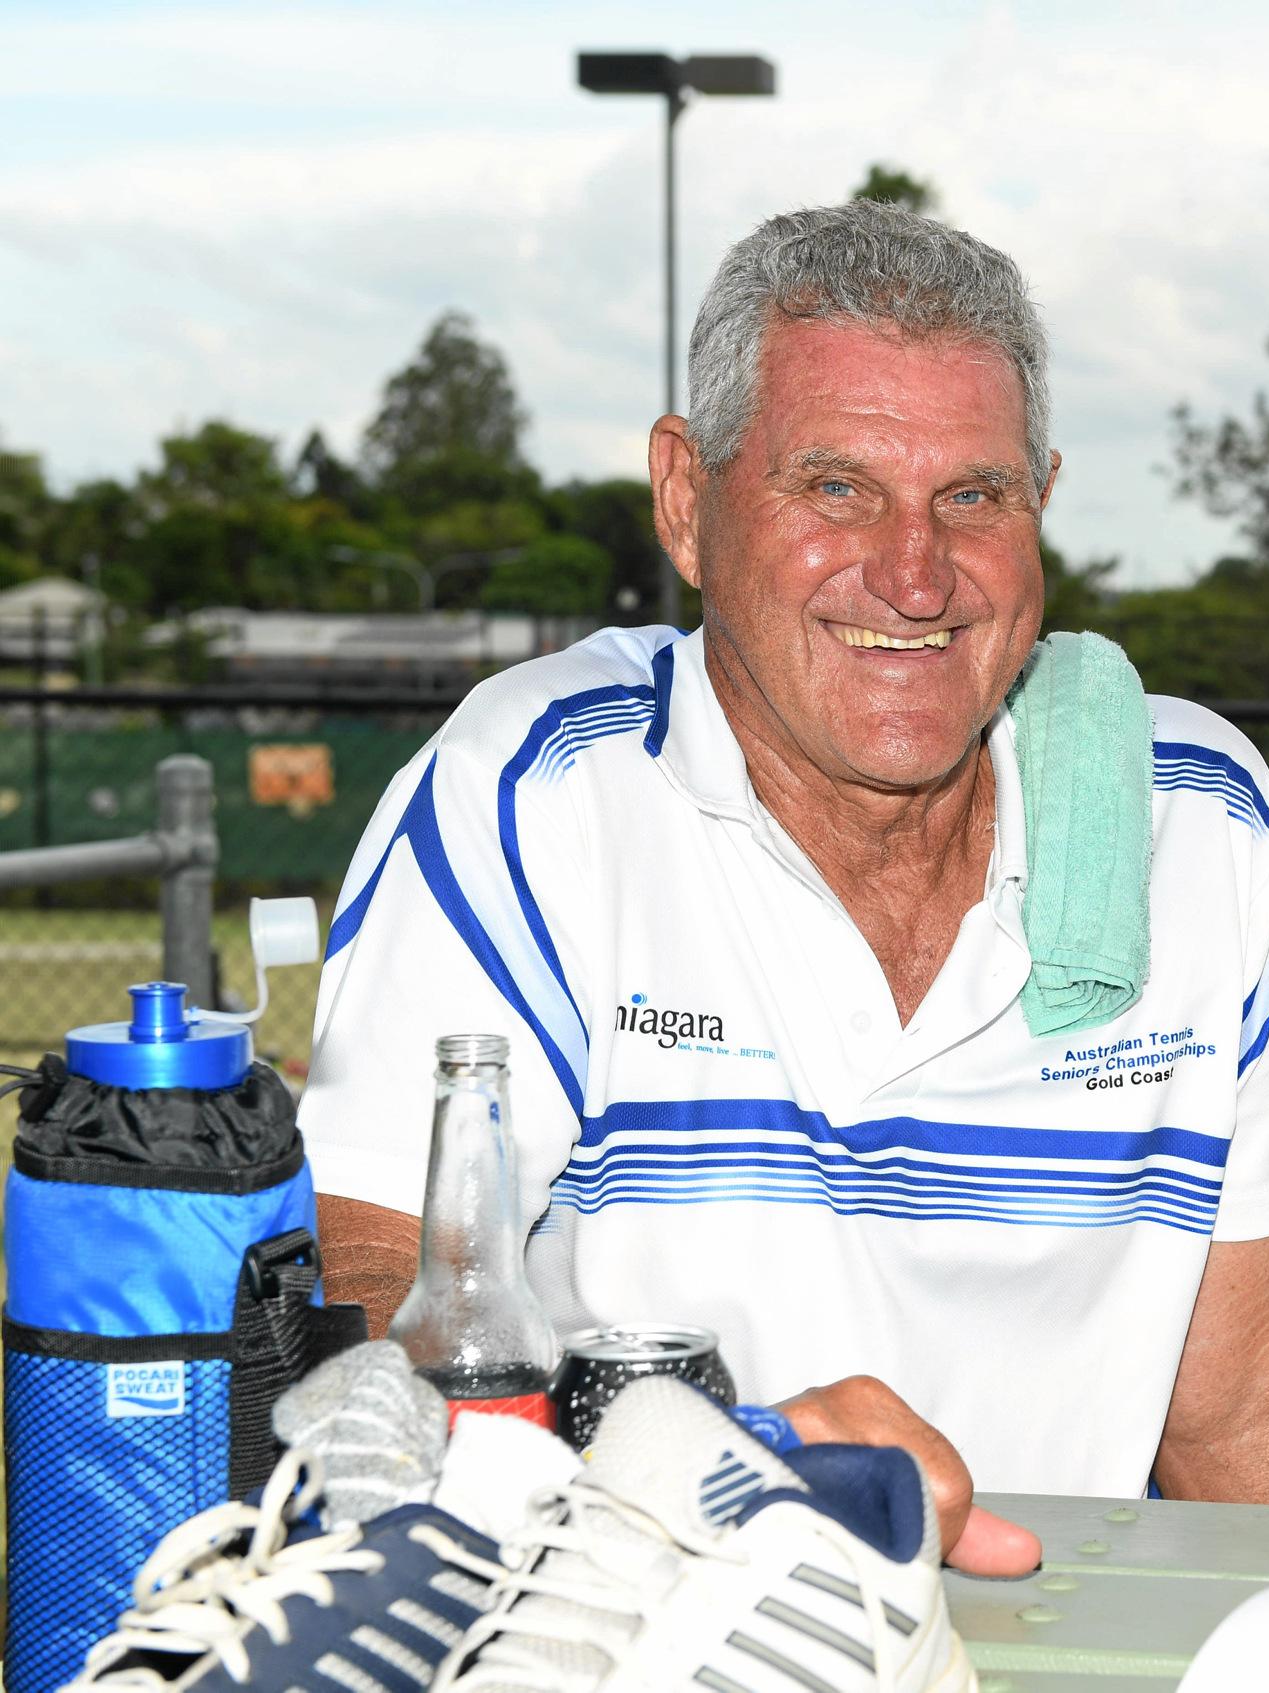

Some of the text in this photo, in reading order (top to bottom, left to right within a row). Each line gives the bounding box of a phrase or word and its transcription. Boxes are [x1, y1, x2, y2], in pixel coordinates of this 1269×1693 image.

[615, 994, 724, 1049] niagara
[716, 1047, 730, 1056] live
[1064, 1026, 1194, 1062] Australian Tennis
[1040, 1042, 1217, 1081] Seniors Championships
[1086, 1074, 1124, 1091] Gold
[113, 1369, 179, 1381] POCARI
[115, 1382, 175, 1394] SWEAT
